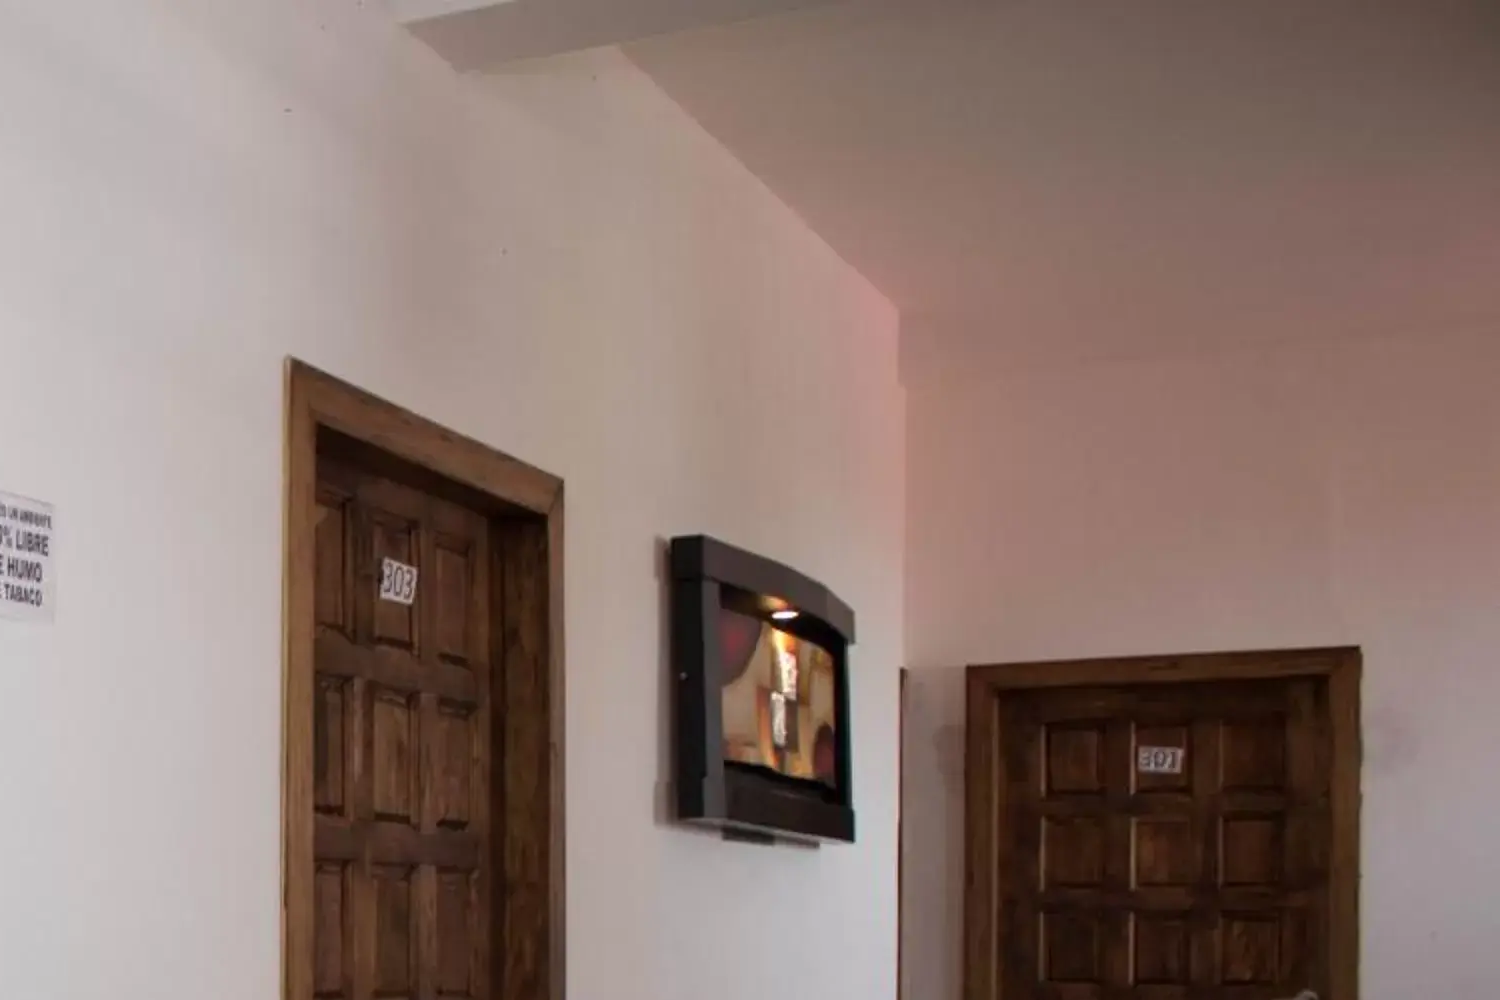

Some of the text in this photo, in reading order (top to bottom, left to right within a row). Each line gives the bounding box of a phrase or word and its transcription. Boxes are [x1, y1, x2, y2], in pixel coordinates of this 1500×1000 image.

[16, 530, 49, 556] LIBRE
[7, 558, 42, 582] HUMO
[383, 562, 412, 599] 303
[4, 583, 42, 607] TABACO
